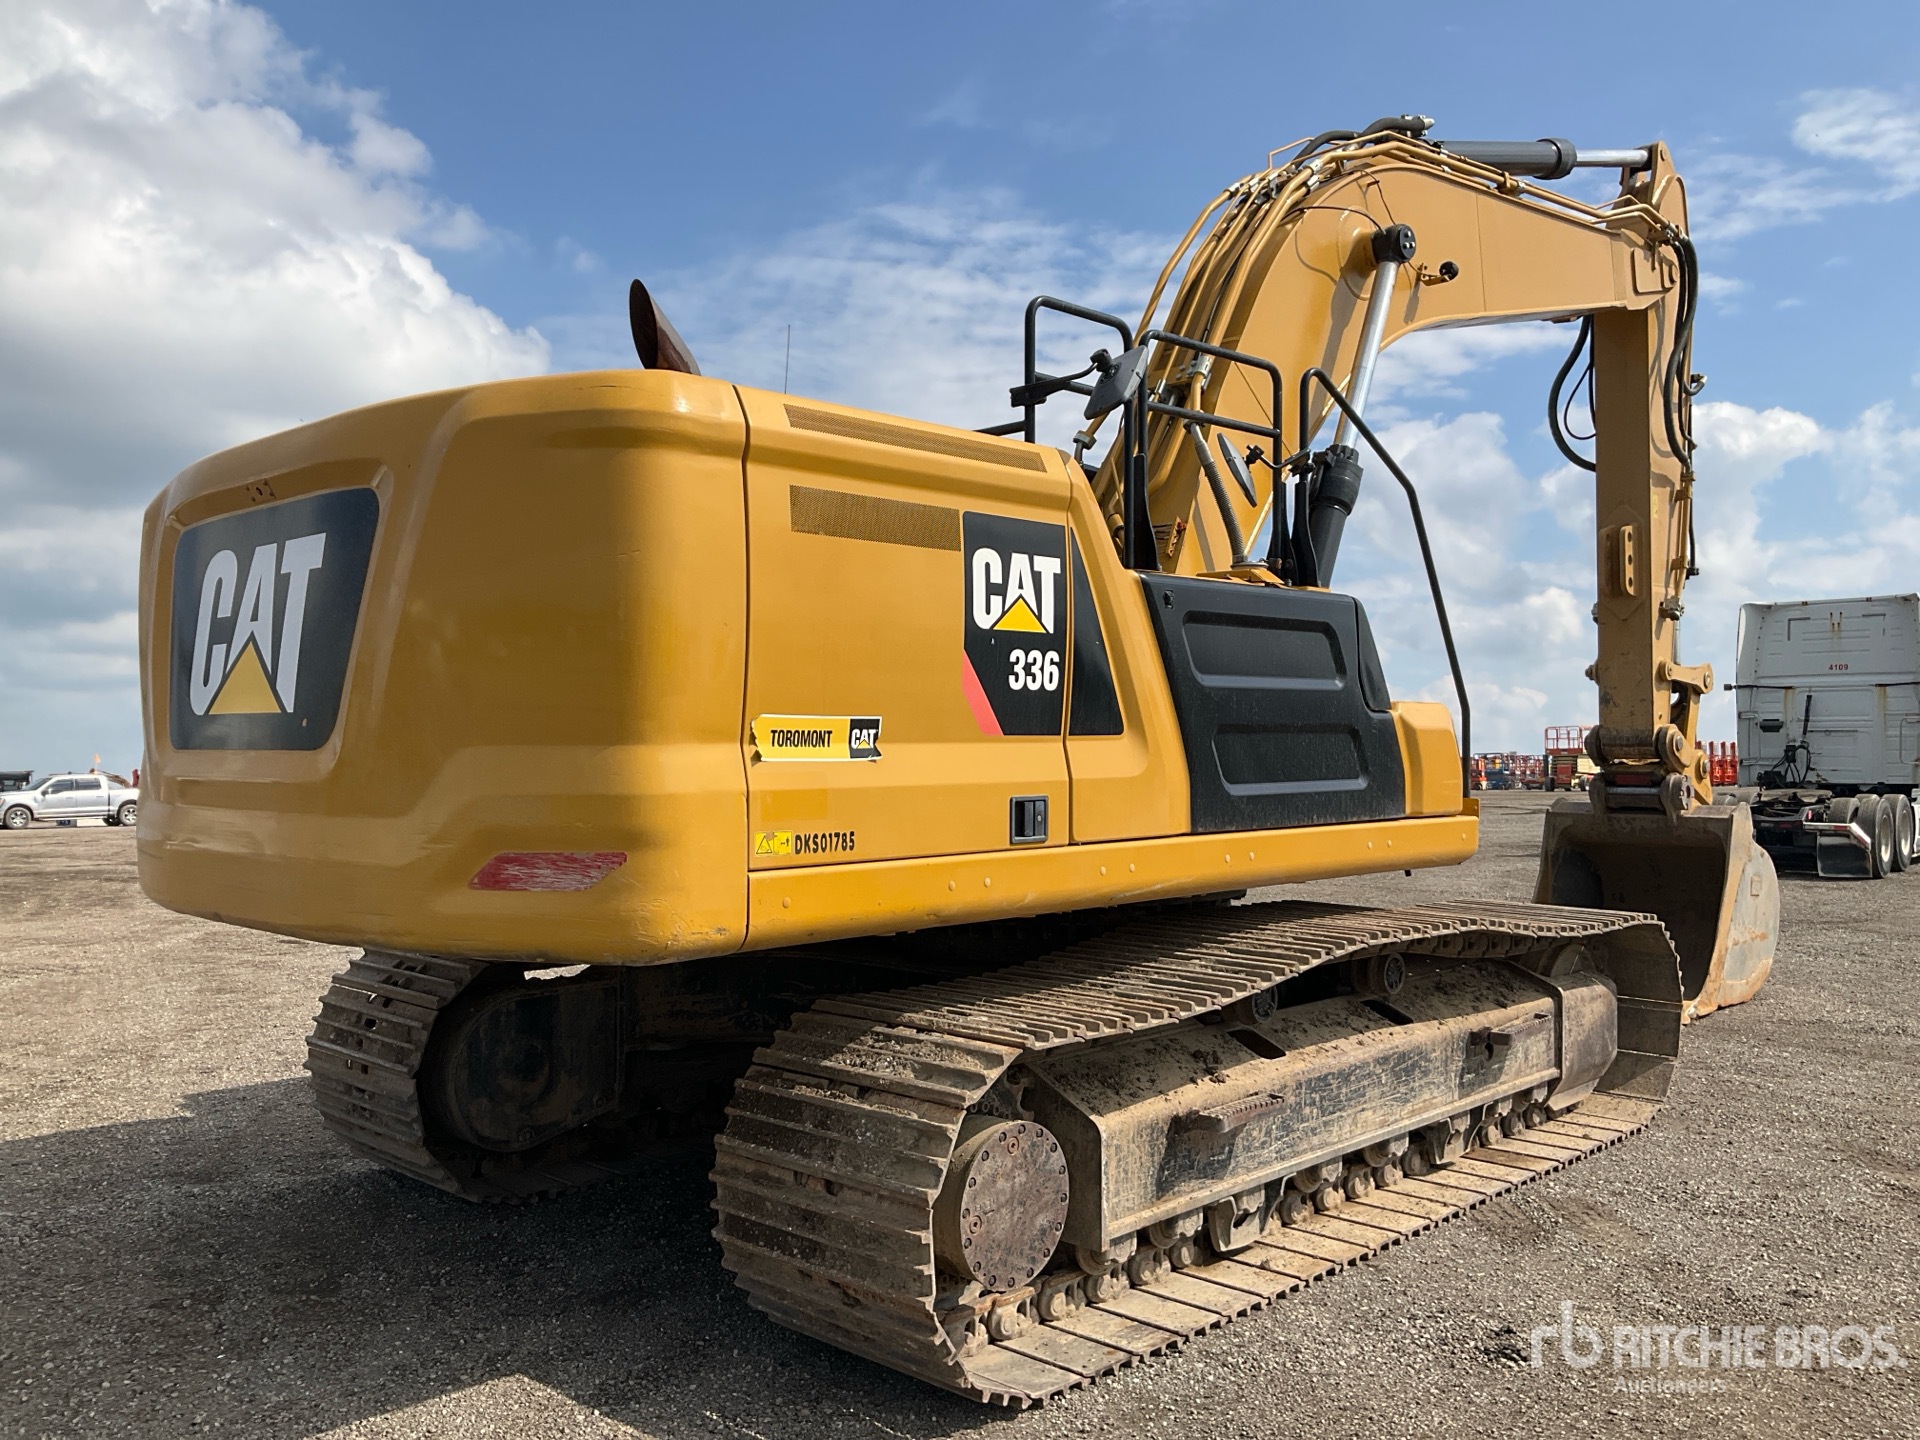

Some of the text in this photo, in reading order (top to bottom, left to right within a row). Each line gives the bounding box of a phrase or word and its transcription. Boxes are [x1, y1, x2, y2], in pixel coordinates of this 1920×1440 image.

[972, 547, 1061, 634] CAT
[190, 532, 326, 715] CAT
[1008, 649, 1060, 691] 336
[1828, 663, 1849, 671] 4109
[770, 729, 833, 748] TOROMONT
[851, 728, 876, 749] CAT
[795, 831, 855, 855] DKS01785
